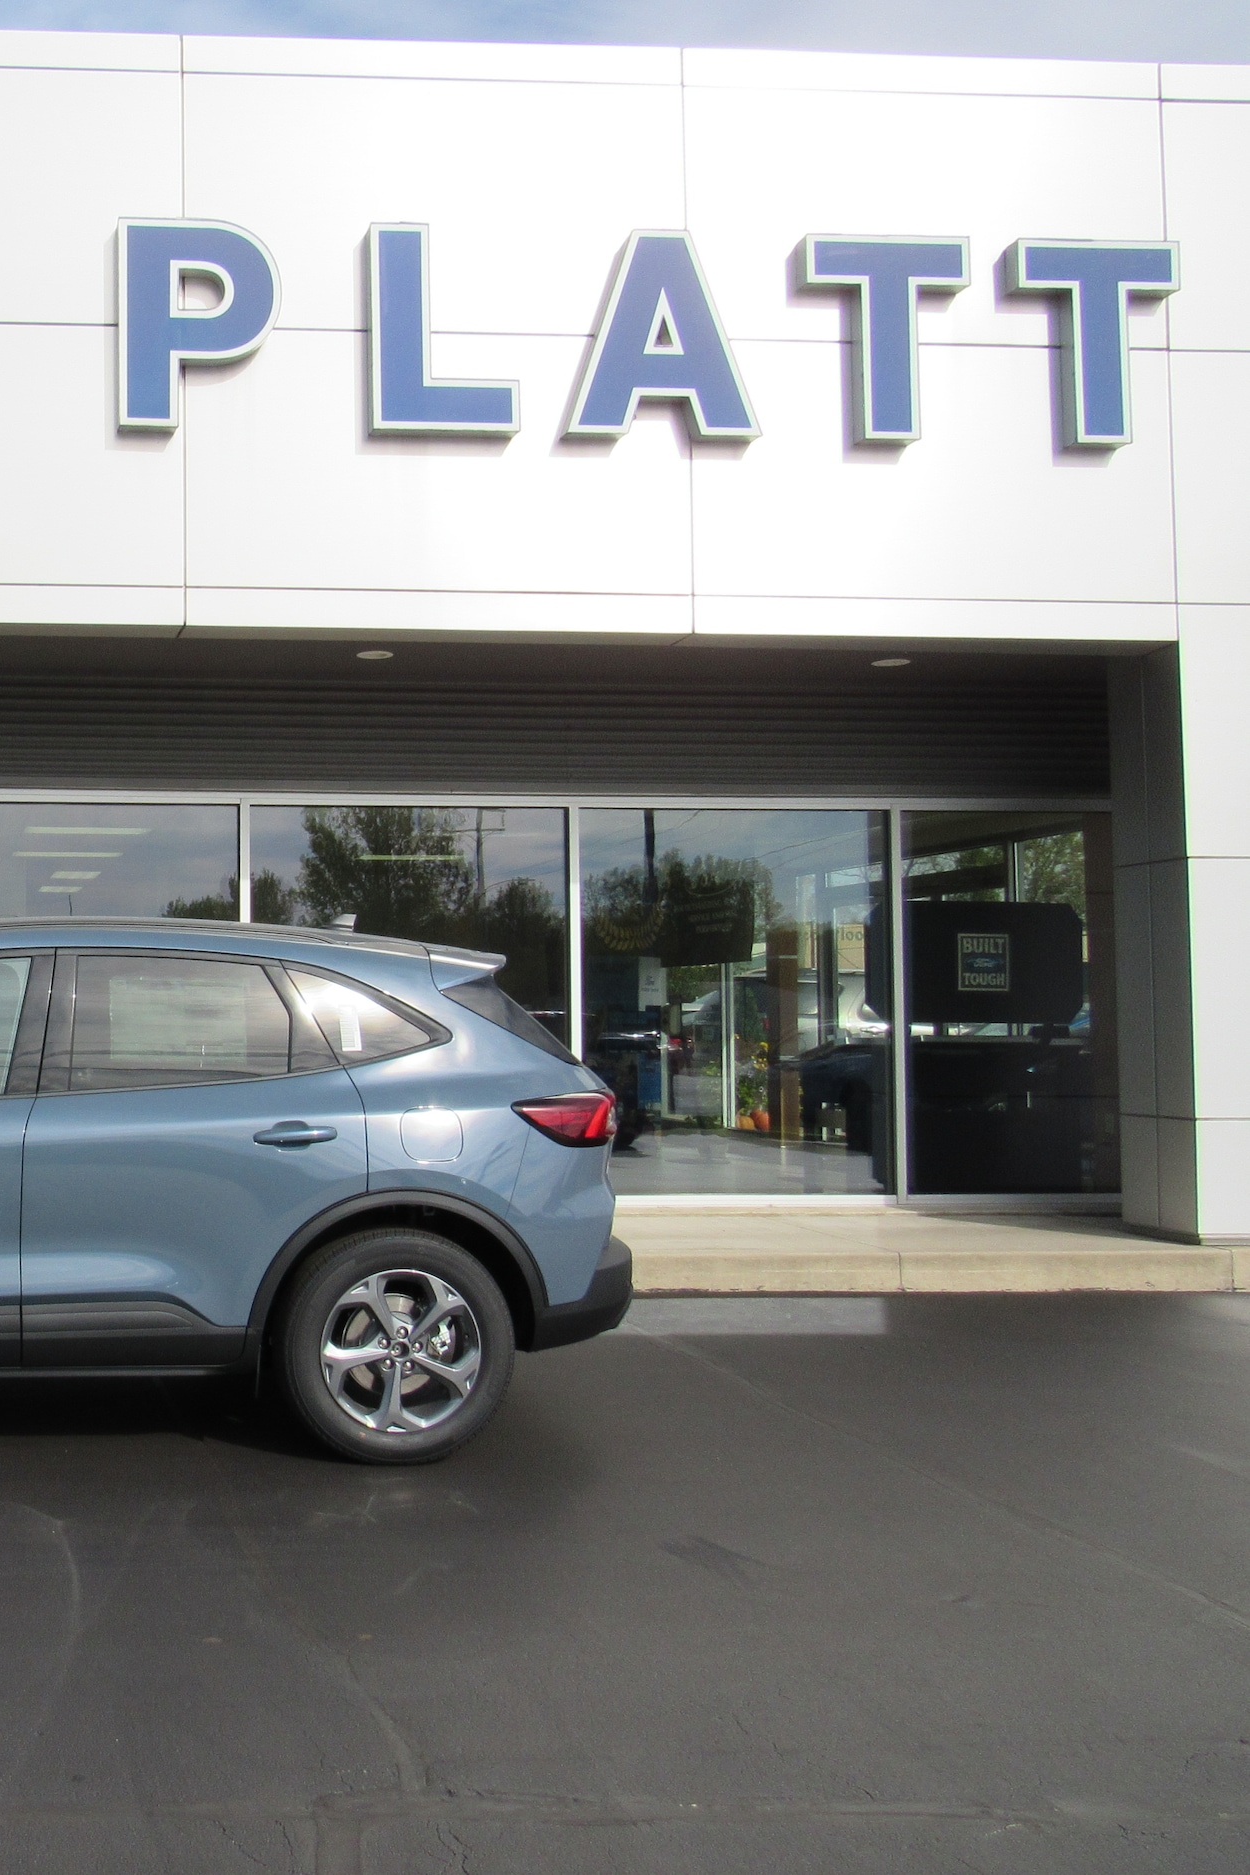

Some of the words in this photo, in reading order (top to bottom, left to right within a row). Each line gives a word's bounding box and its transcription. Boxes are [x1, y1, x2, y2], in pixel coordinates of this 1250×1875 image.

[117, 216, 1180, 444] PLATT
[963, 938, 1005, 954] BUILT
[963, 972, 1005, 986] TOUGH
